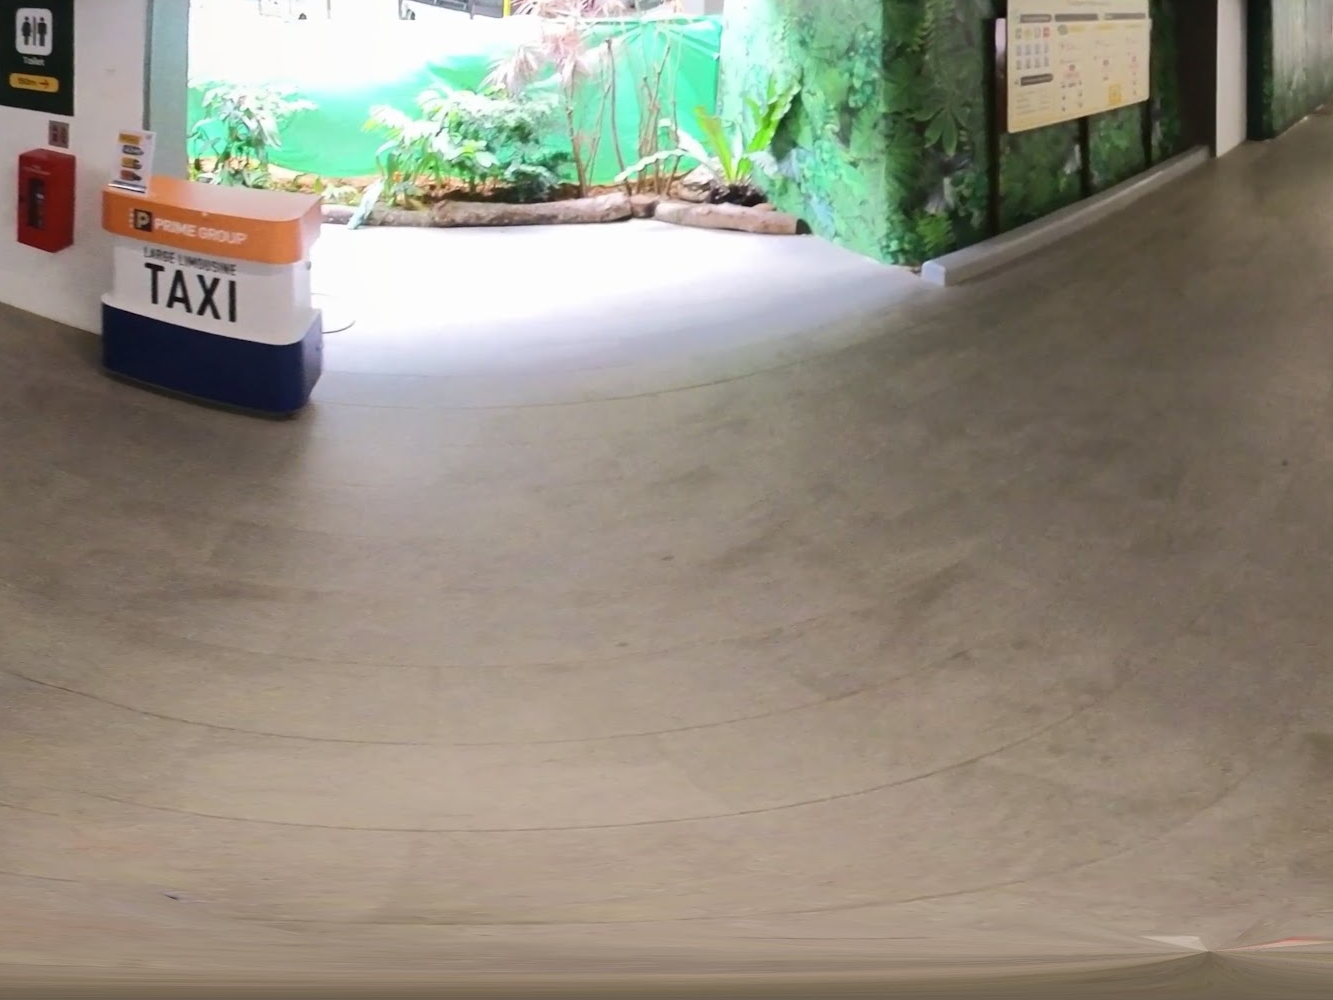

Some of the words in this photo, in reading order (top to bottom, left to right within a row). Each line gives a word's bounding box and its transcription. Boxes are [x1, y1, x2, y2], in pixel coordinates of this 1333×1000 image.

[23, 56, 45, 66] Toilet
[154, 217, 197, 238] PRIME
[197, 226, 248, 245] GROUP
[143, 246, 175, 264] LARGE
[177, 254, 237, 276] LIMOUSINE
[144, 261, 237, 323] TAXI
